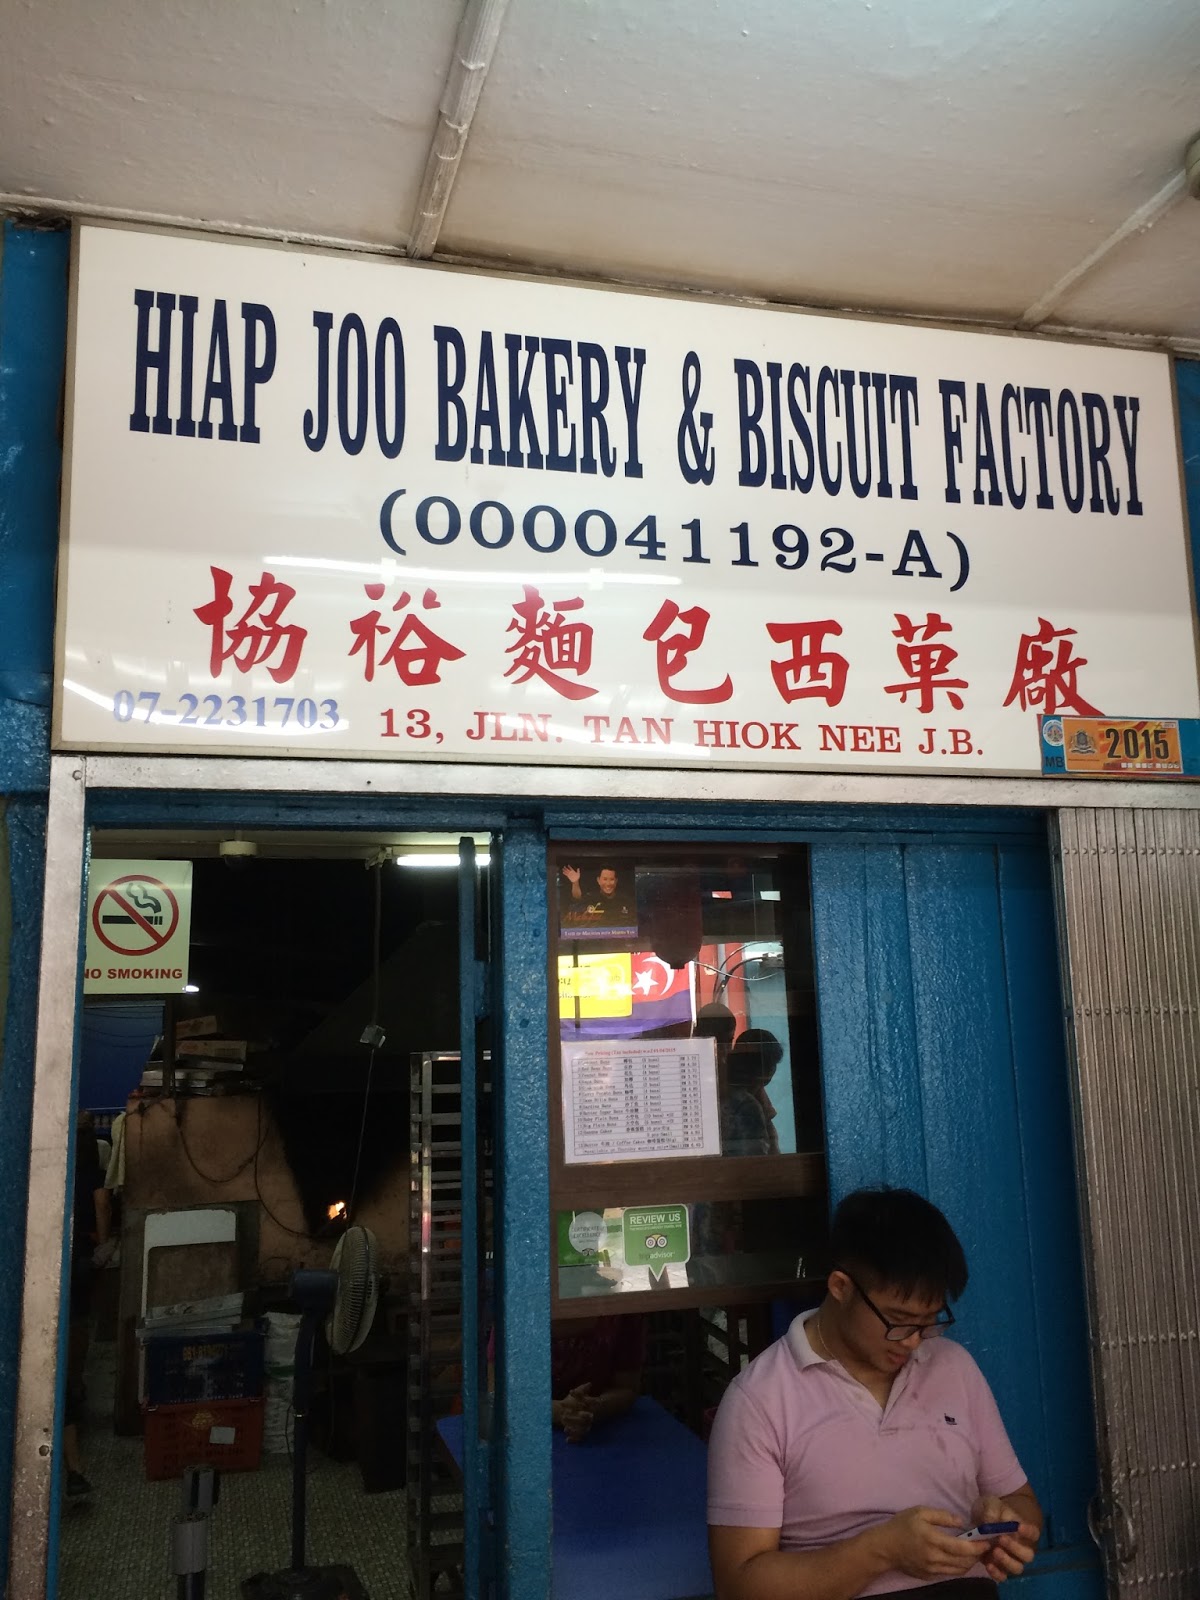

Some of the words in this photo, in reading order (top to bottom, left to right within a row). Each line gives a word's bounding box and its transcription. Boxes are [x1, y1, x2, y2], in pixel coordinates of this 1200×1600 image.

[130, 289, 277, 443] HIAP
[303, 311, 405, 458] JOO
[434, 325, 646, 478] BAKERY
[677, 351, 715, 485] &
[734, 359, 919, 500] BISCUIT
[939, 380, 1143, 515] FACTORY
[379, 488, 970, 591] (000041192-A)
[114, 690, 340, 729] 07-2231703
[379, 708, 445, 744] 13,
[466, 711, 563, 744] JLN.
[583, 715, 675, 745] TAN
[693, 719, 802, 751] HIOK
[817, 723, 902, 754] NEE
[917, 727, 984, 756] J.B.
[1105, 728, 1170, 760] 2015
[107, 968, 183, 980] SMOKING
[630, 1214, 665, 1225] REVIEW
[668, 1213, 681, 1222] US
